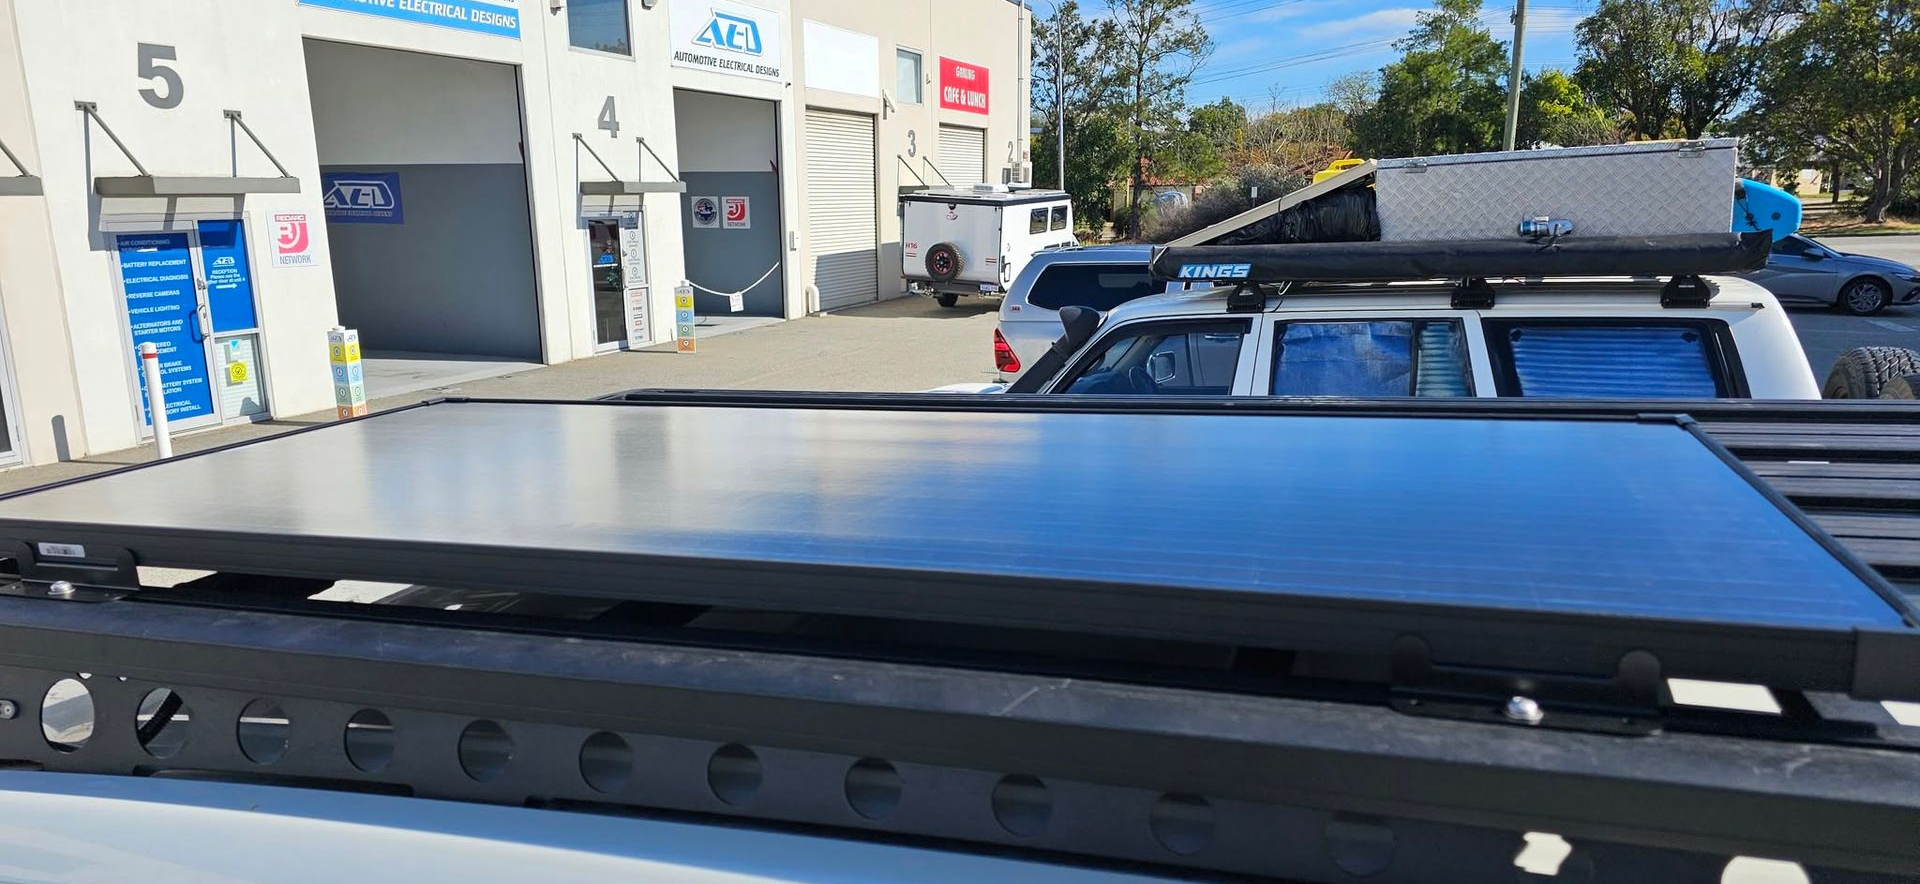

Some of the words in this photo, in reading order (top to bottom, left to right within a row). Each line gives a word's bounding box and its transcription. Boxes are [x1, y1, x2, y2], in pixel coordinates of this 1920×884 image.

[399, 0, 468, 20] ELECTRICAL
[471, 9, 516, 29] DESIGNS
[674, 51, 717, 67] AUTOMOTIVE
[719, 59, 754, 73] ELECTRICAL
[755, 65, 780, 77] DESIGNS
[137, 42, 184, 109] 5
[944, 86, 959, 103] CAFE
[960, 89, 966, 105] &
[967, 90, 986, 108] LUNCH
[598, 96, 619, 138] 4
[907, 130, 916, 157] 3
[1008, 141, 1014, 163] 2
[275, 214, 305, 222] REDARC
[148, 259, 186, 267] REPLACEMENT
[280, 255, 312, 264] NETWORK
[1178, 264, 1251, 278] KINGS
[126, 276, 159, 284] ELECTRICAL
[128, 291, 153, 299] REVERSE
[154, 289, 180, 297] CAMERAS
[130, 307, 154, 315] VEHICLE
[133, 321, 171, 329] ALTERNATORS
[134, 328, 159, 336] STARTER
[168, 365, 192, 374] SYSTEMS
[183, 377, 202, 385] SYSTEM
[180, 404, 201, 412] INSTALL
